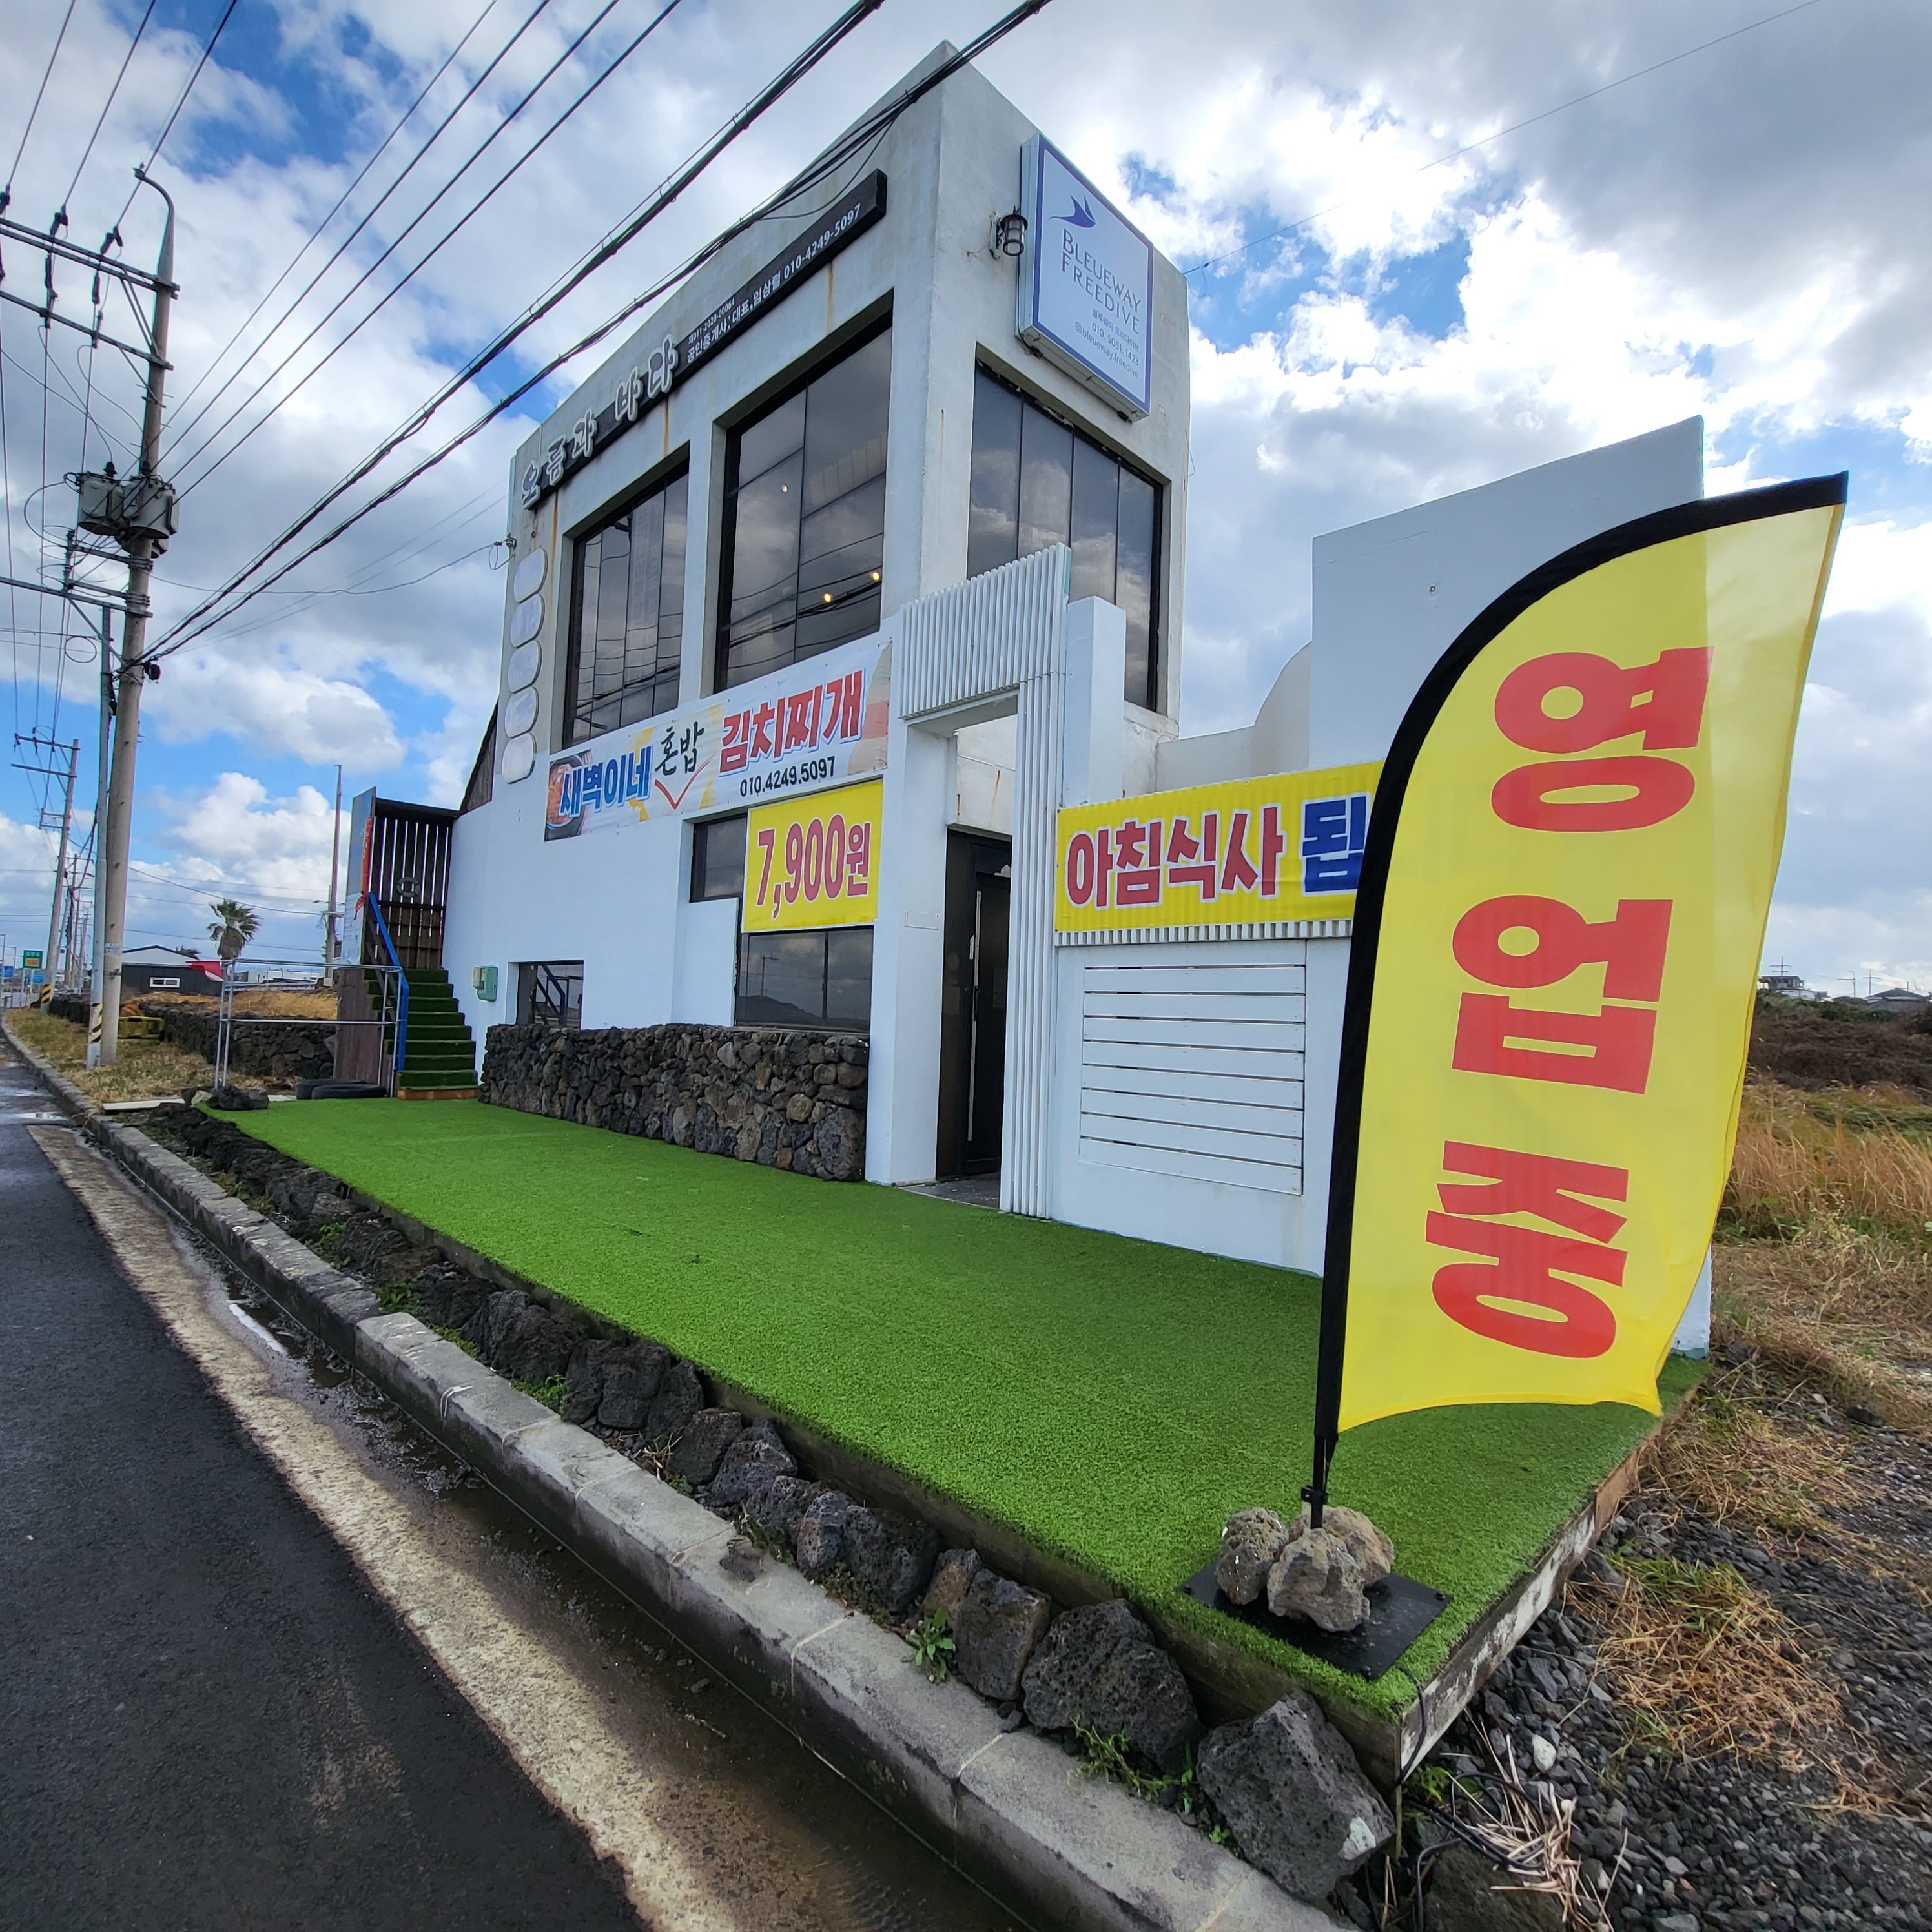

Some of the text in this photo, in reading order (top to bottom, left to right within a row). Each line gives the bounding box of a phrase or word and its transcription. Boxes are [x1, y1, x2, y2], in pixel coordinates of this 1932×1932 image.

[783, 202, 861, 280] 010-4249-5097
[1062, 227, 1141, 313] BLEUEWAY
[1062, 251, 1140, 335] FREEDIVE
[522, 334, 678, 510] 오름과 바다
[559, 667, 866, 817] 새벽이네 혼밥 김치찌개
[739, 755, 836, 798] 010.4249.5097
[755, 814, 872, 920] 7,900원
[1066, 806, 1284, 908] 아침식사
[1425, 646, 1714, 1359] 영업중
